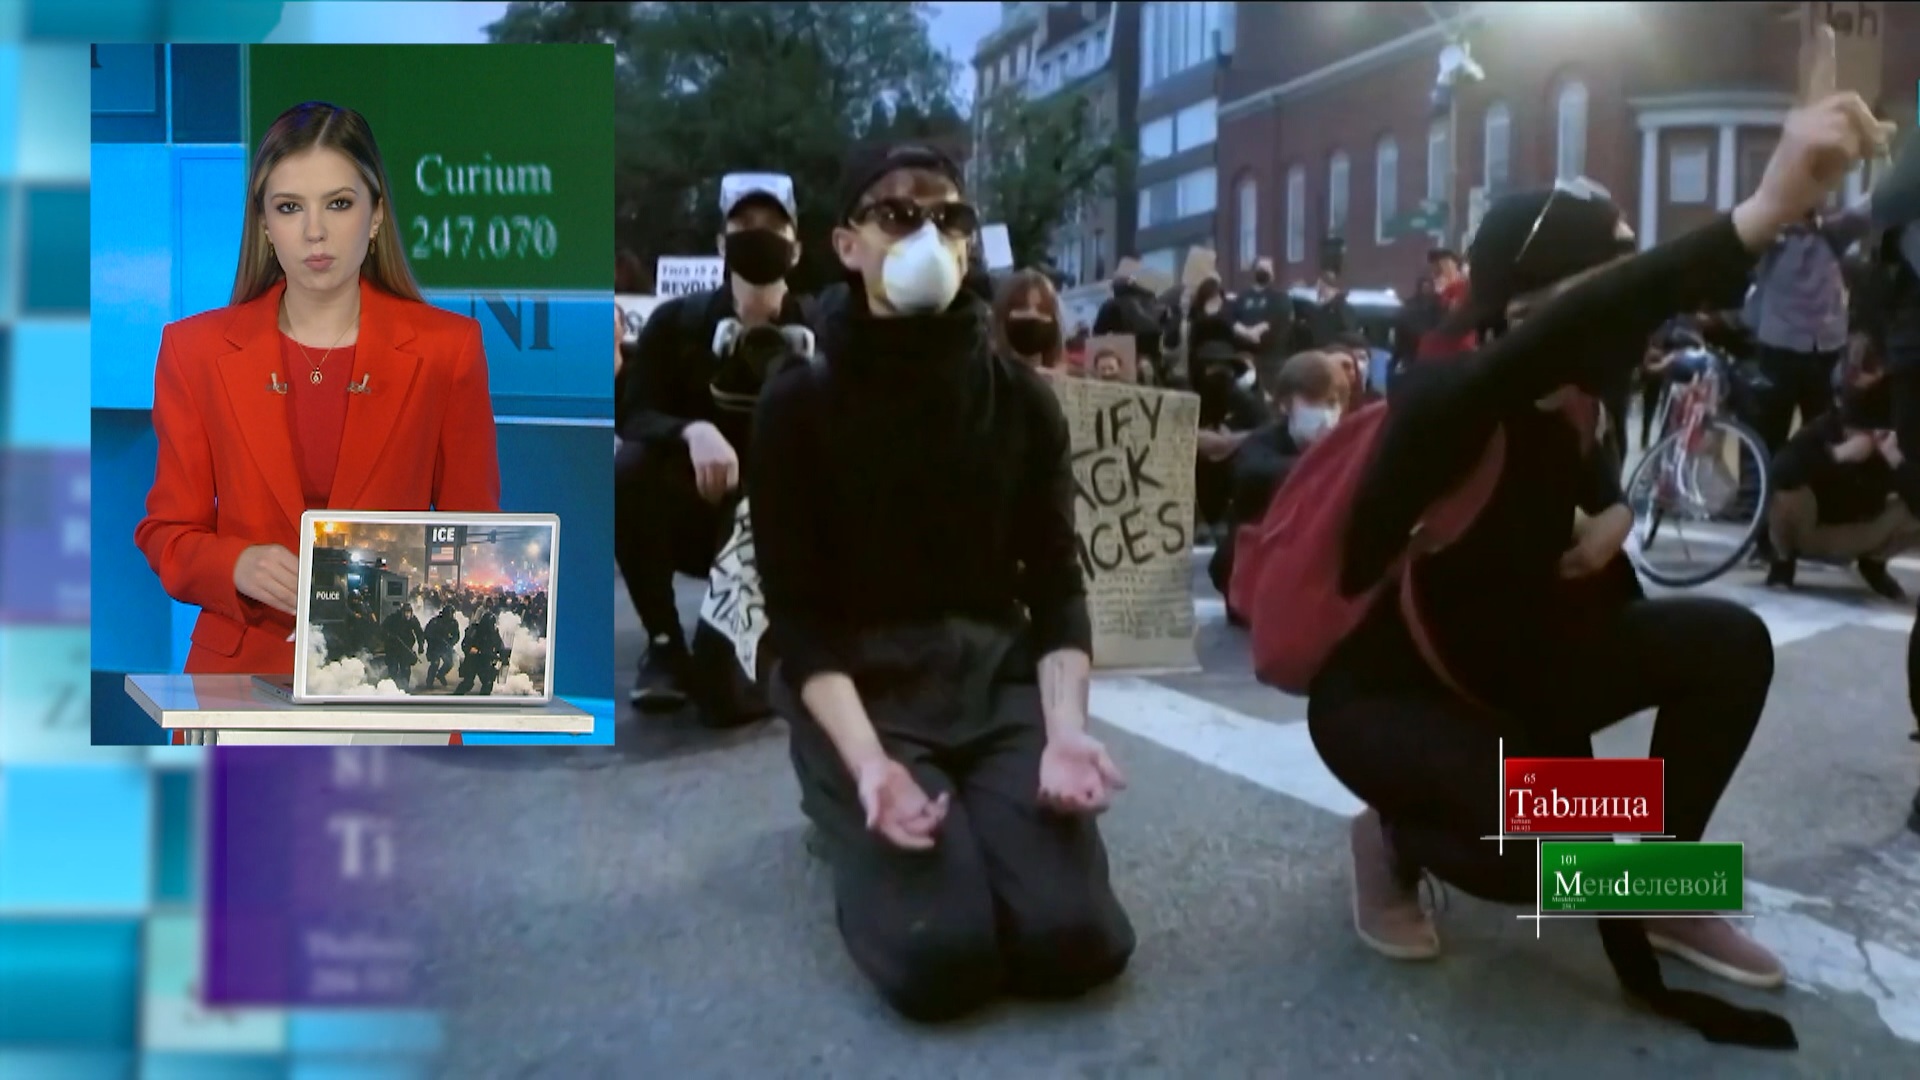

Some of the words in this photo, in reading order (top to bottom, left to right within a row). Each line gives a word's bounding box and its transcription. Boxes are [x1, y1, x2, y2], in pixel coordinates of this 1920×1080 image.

[415, 153, 553, 196] Curium
[412, 214, 558, 260] 247.070
[432, 527, 455, 542] ICE
[316, 590, 340, 600] POLICE
